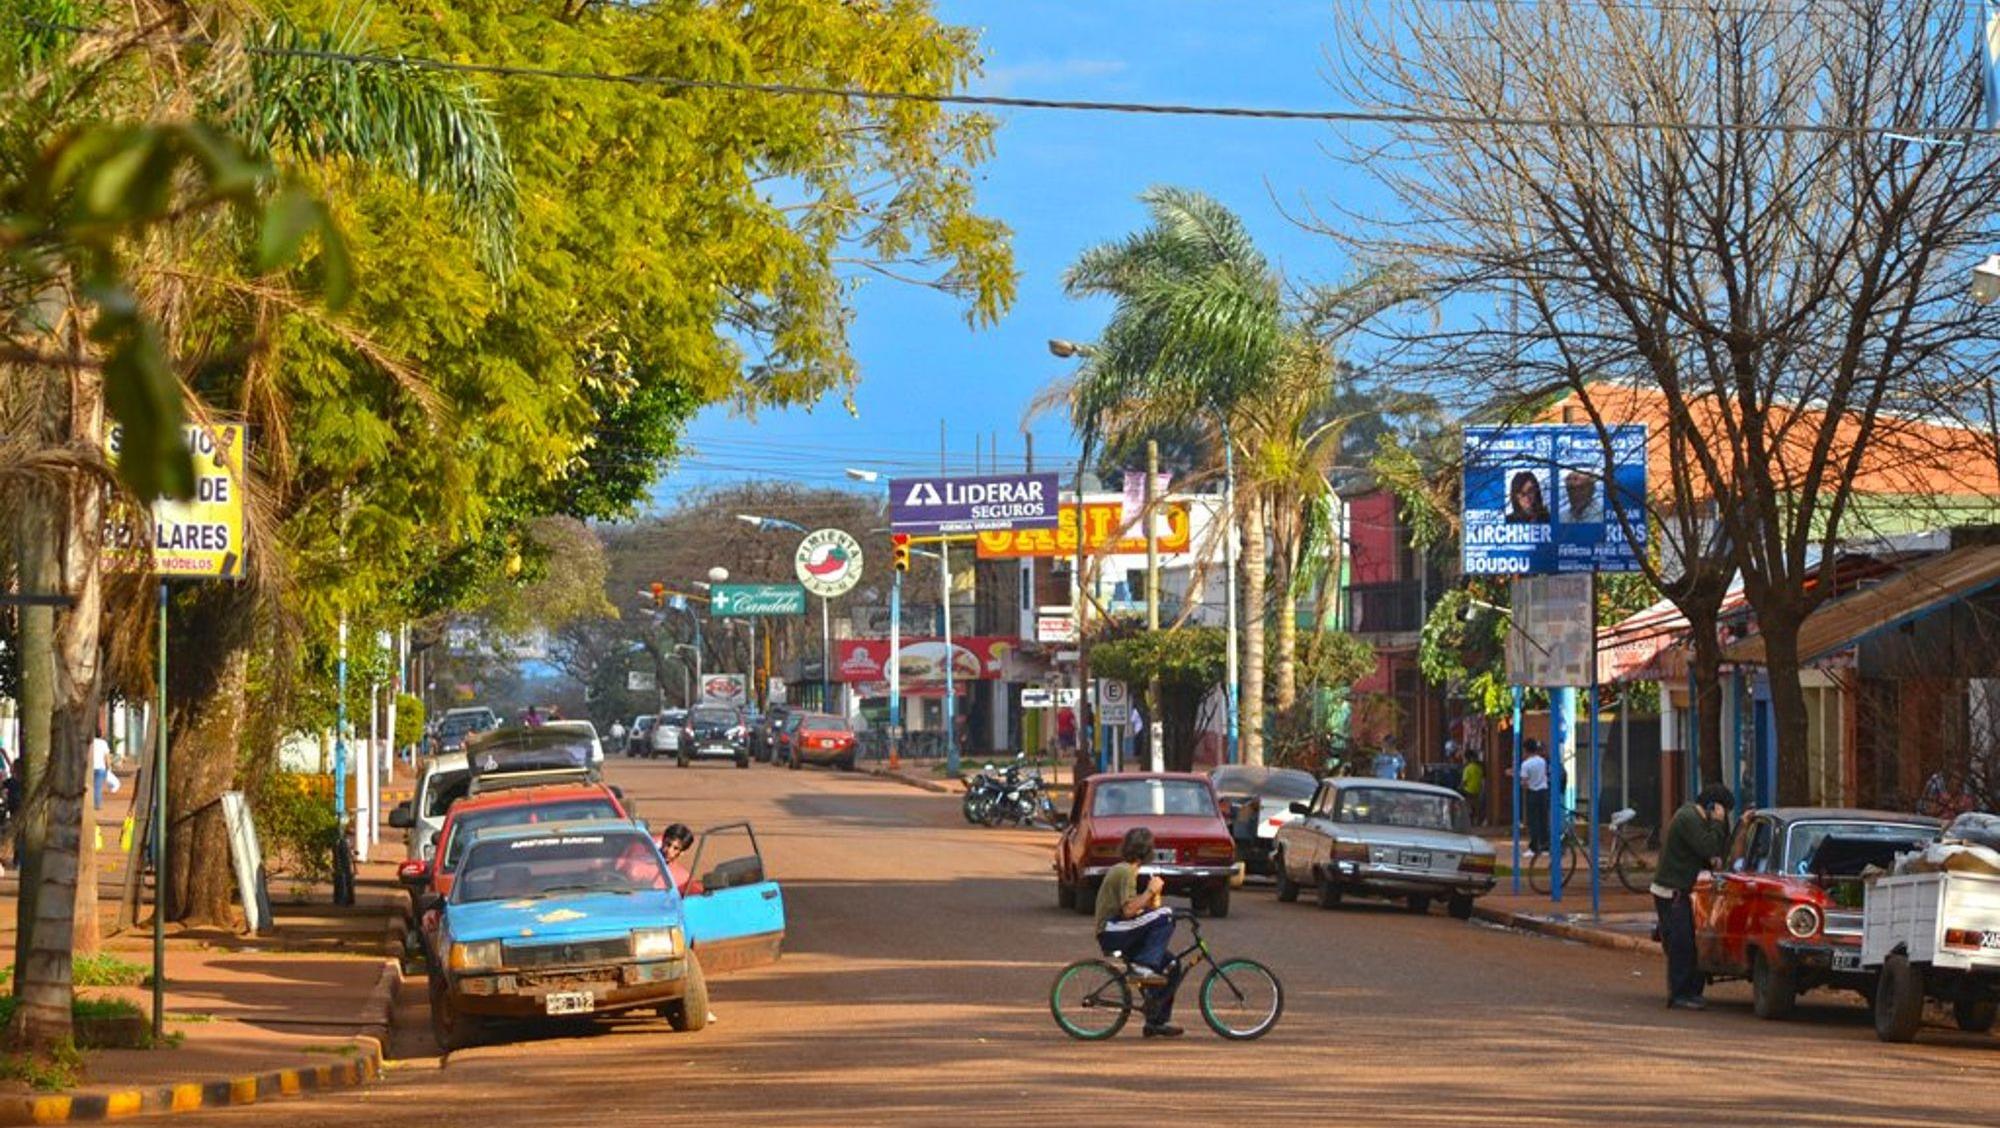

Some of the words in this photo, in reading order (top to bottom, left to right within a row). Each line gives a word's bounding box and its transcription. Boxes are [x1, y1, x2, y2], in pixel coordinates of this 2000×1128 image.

[200, 477, 227, 502] DE
[945, 481, 1044, 505] LIDERAR
[971, 502, 1044, 519] SEGUROS
[1465, 524, 1552, 544] KIRCHNER
[798, 530, 861, 563] PIMIENTA
[161, 557, 213, 570] MODELOS
[1465, 557, 1530, 572] BOUDOU
[732, 592, 798, 613] Candela
[1109, 685, 1118, 698] E
